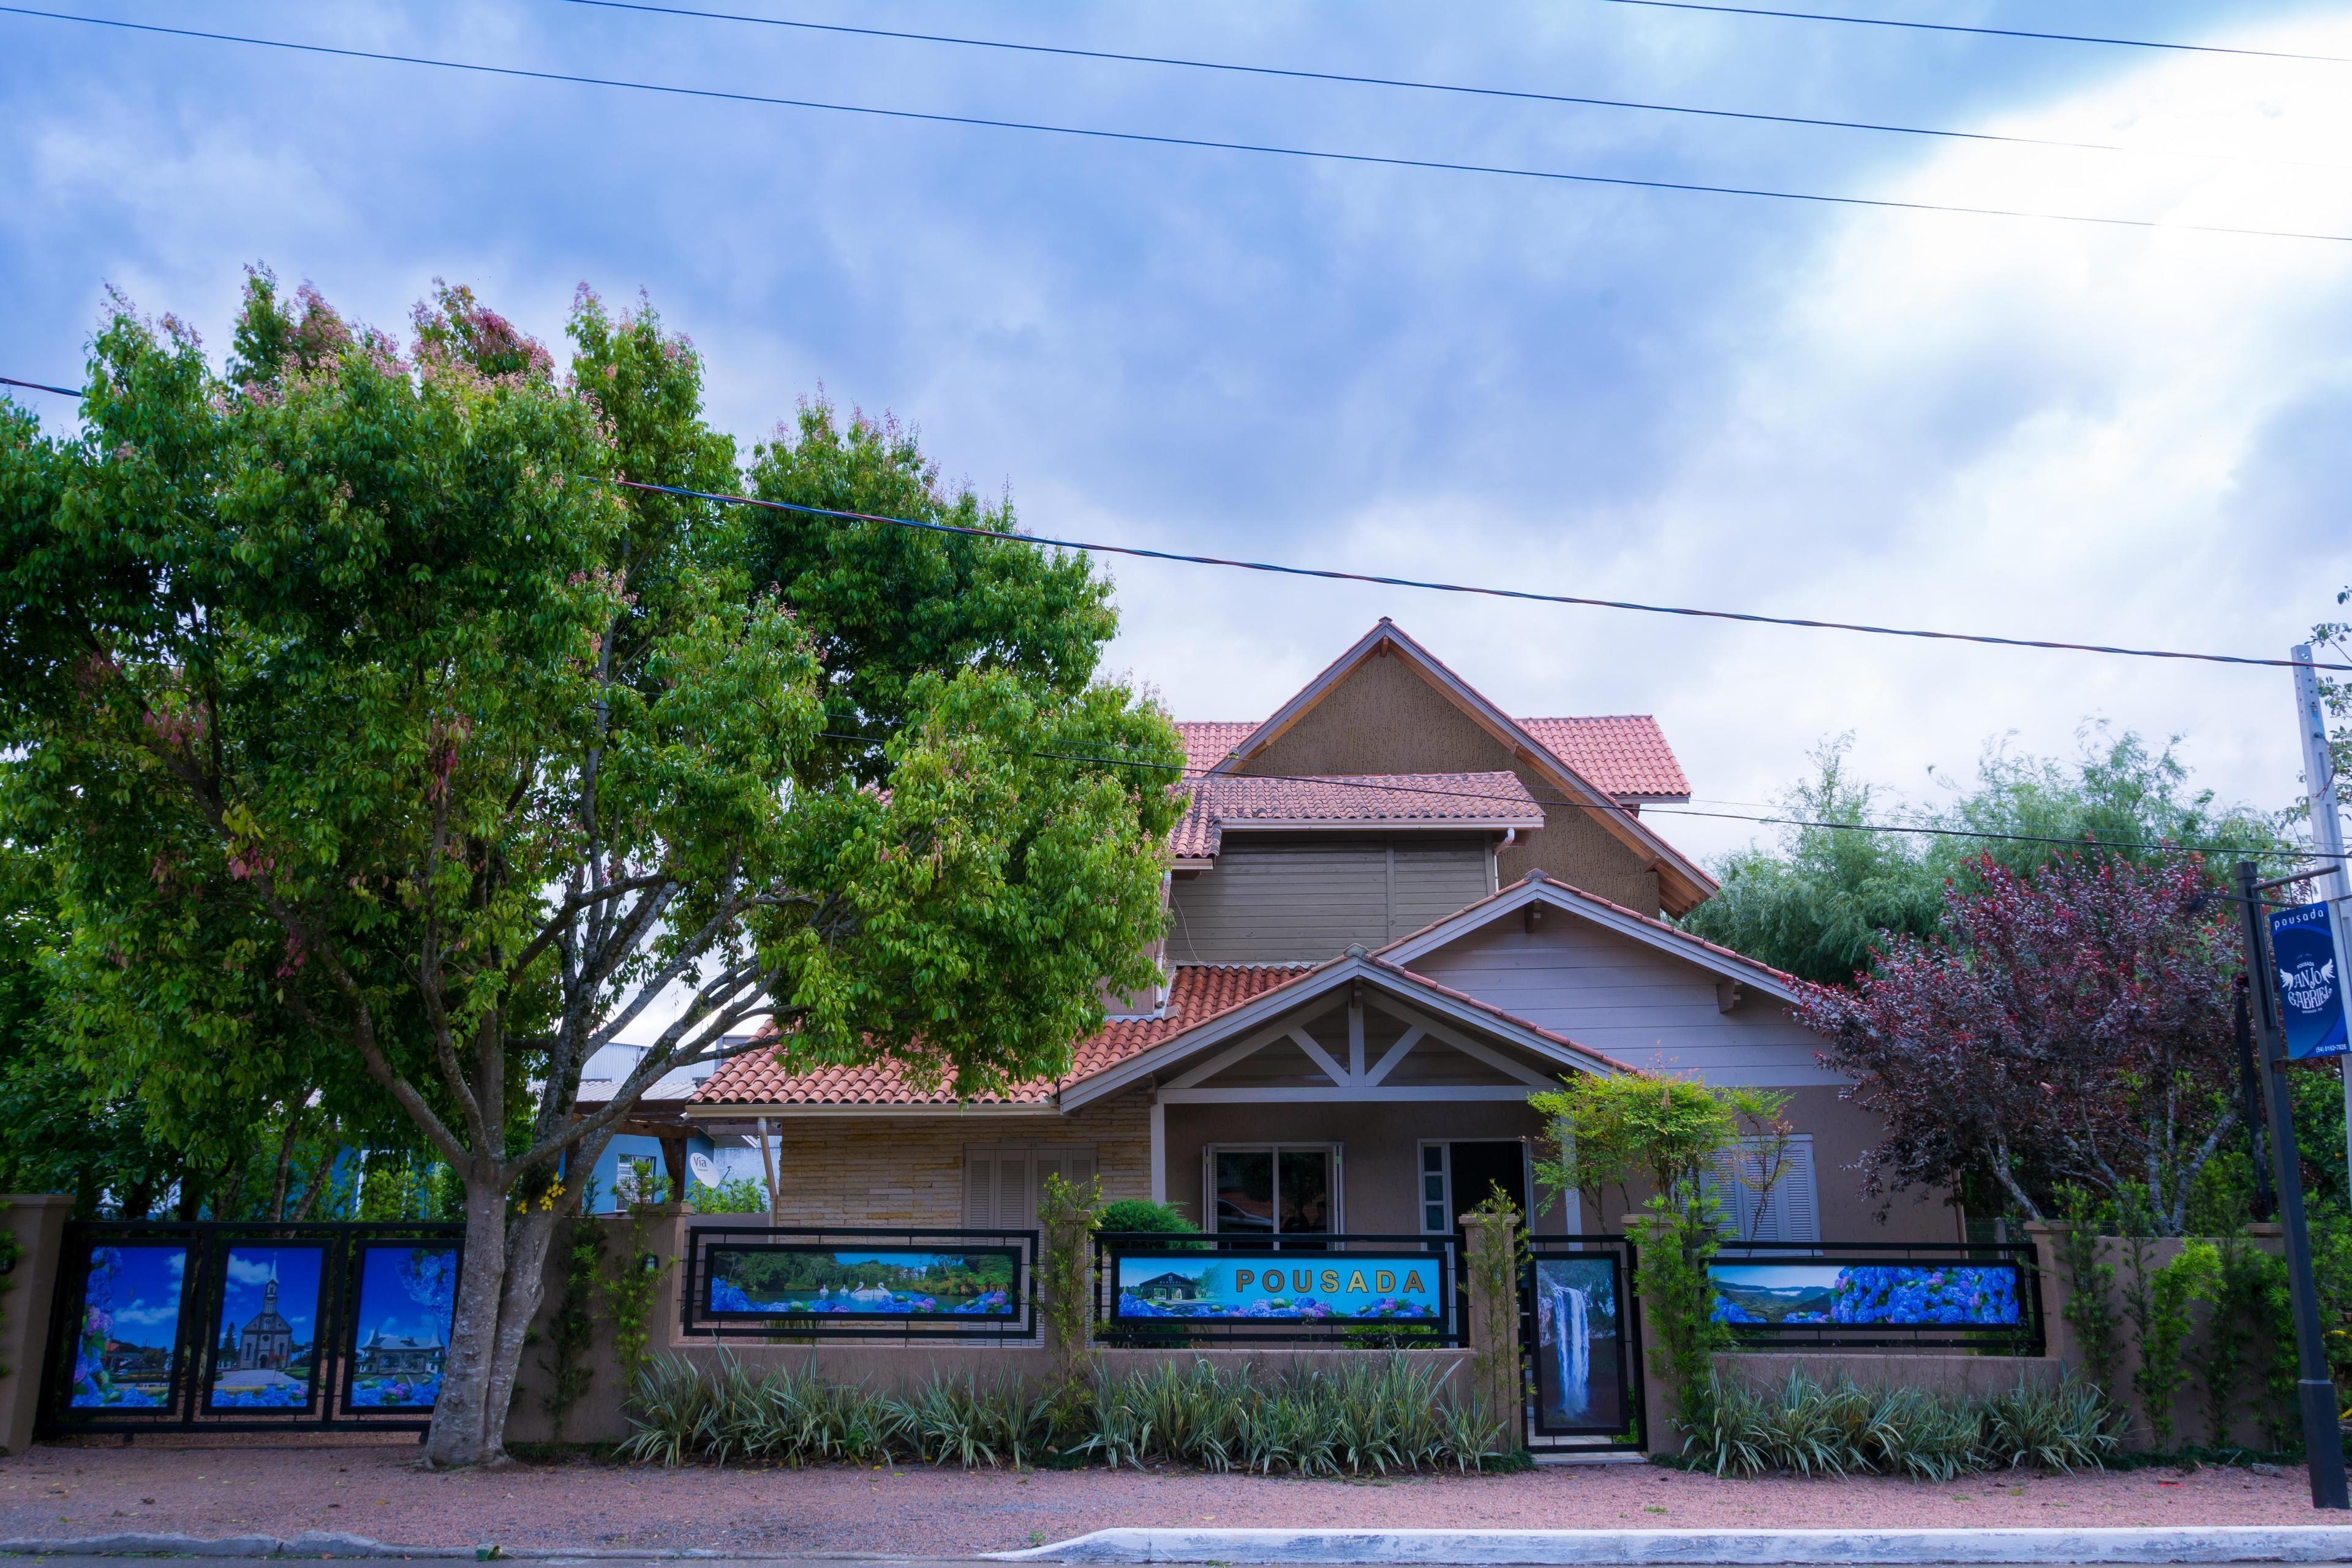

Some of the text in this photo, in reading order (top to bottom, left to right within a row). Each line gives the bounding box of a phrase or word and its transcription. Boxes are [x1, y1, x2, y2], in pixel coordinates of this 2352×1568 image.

[2274, 908, 2324, 930] pousada
[2294, 967, 2322, 989] ANJO
[2288, 985, 2332, 1009] GABRIEL
[693, 1156, 707, 1167] Via
[1235, 1269, 1426, 1294] POUSADA
